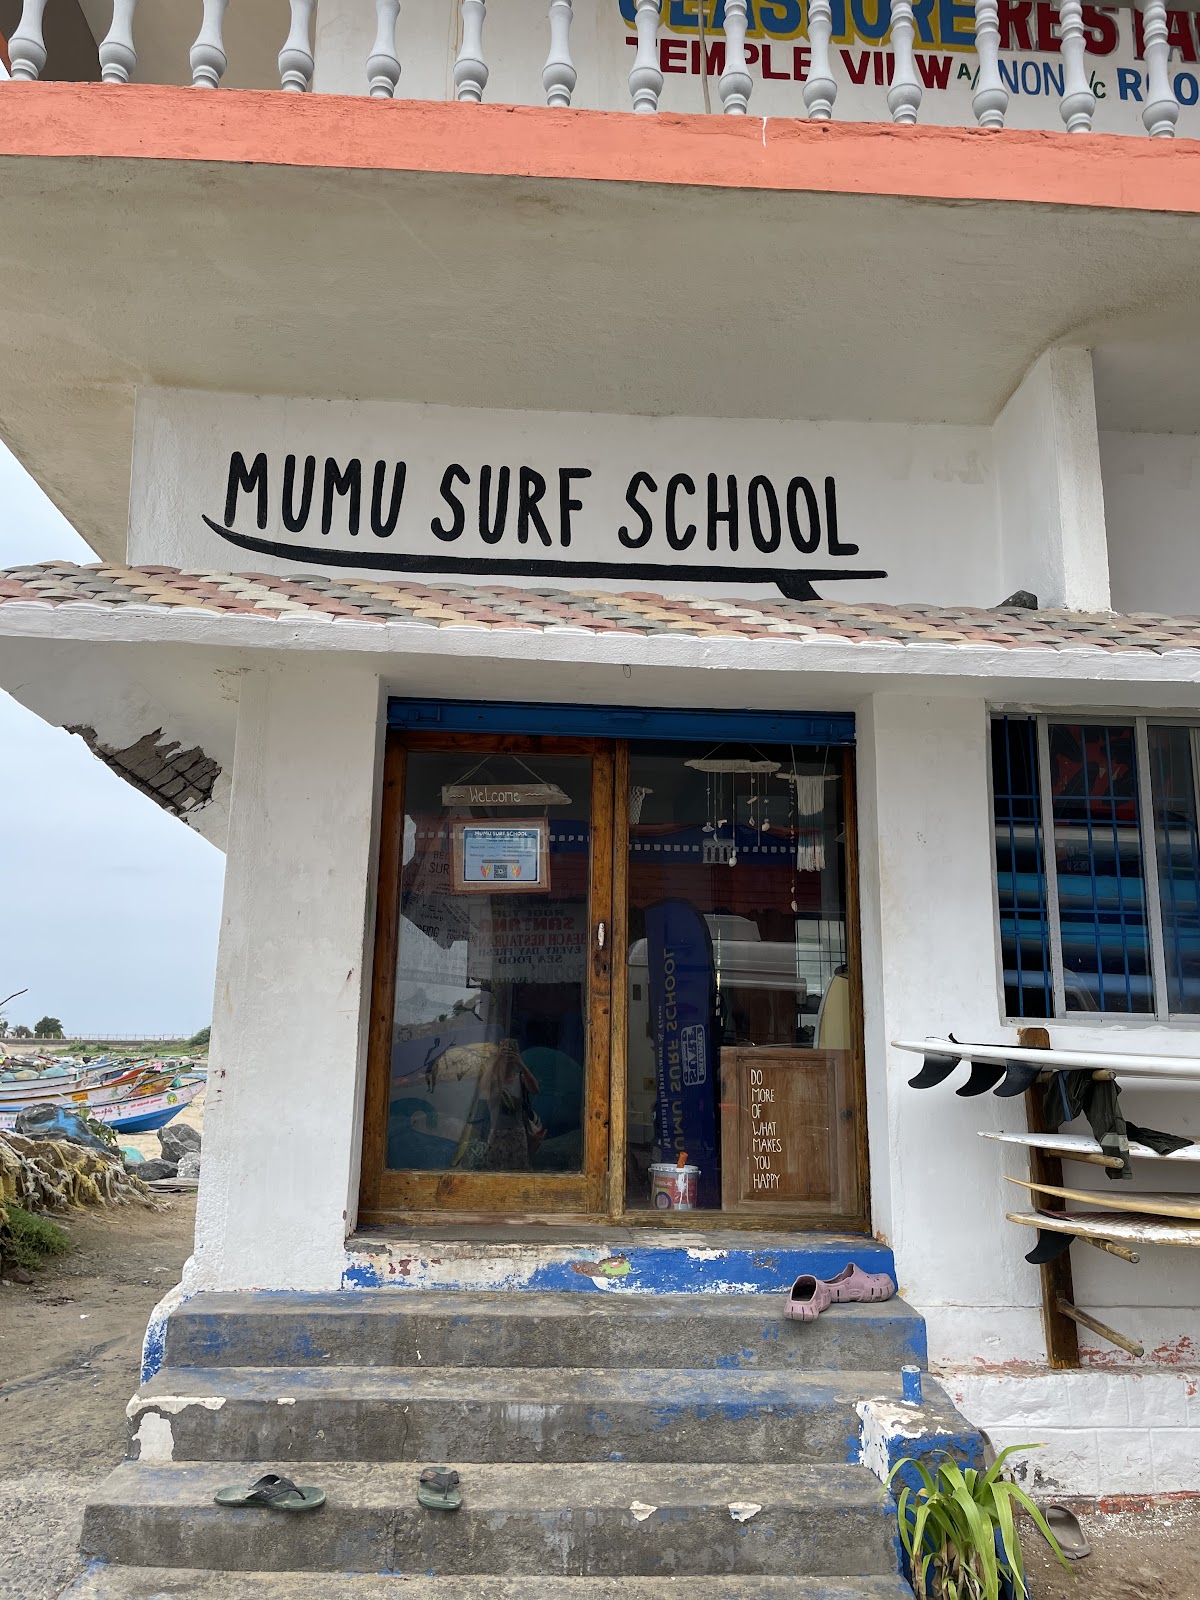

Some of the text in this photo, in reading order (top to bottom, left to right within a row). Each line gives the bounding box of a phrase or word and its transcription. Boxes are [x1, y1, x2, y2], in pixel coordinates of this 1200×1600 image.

[839, 49, 953, 90] VIW
[957, 63, 981, 90] A/
[998, 59, 1065, 97] NON
[1089, 70, 1107, 98] /C
[1117, 67, 1199, 106] RO
[224, 451, 860, 557] MUMU SURF SCHOOL
[750, 1069, 763, 1086] DO
[751, 1088, 775, 1103] MORE
[751, 1103, 762, 1119] OF
[752, 1121, 777, 1137] WHAT
[752, 1138, 783, 1153] MAKES
[753, 1155, 771, 1170] YOU
[753, 1173, 781, 1190] HAPPY
